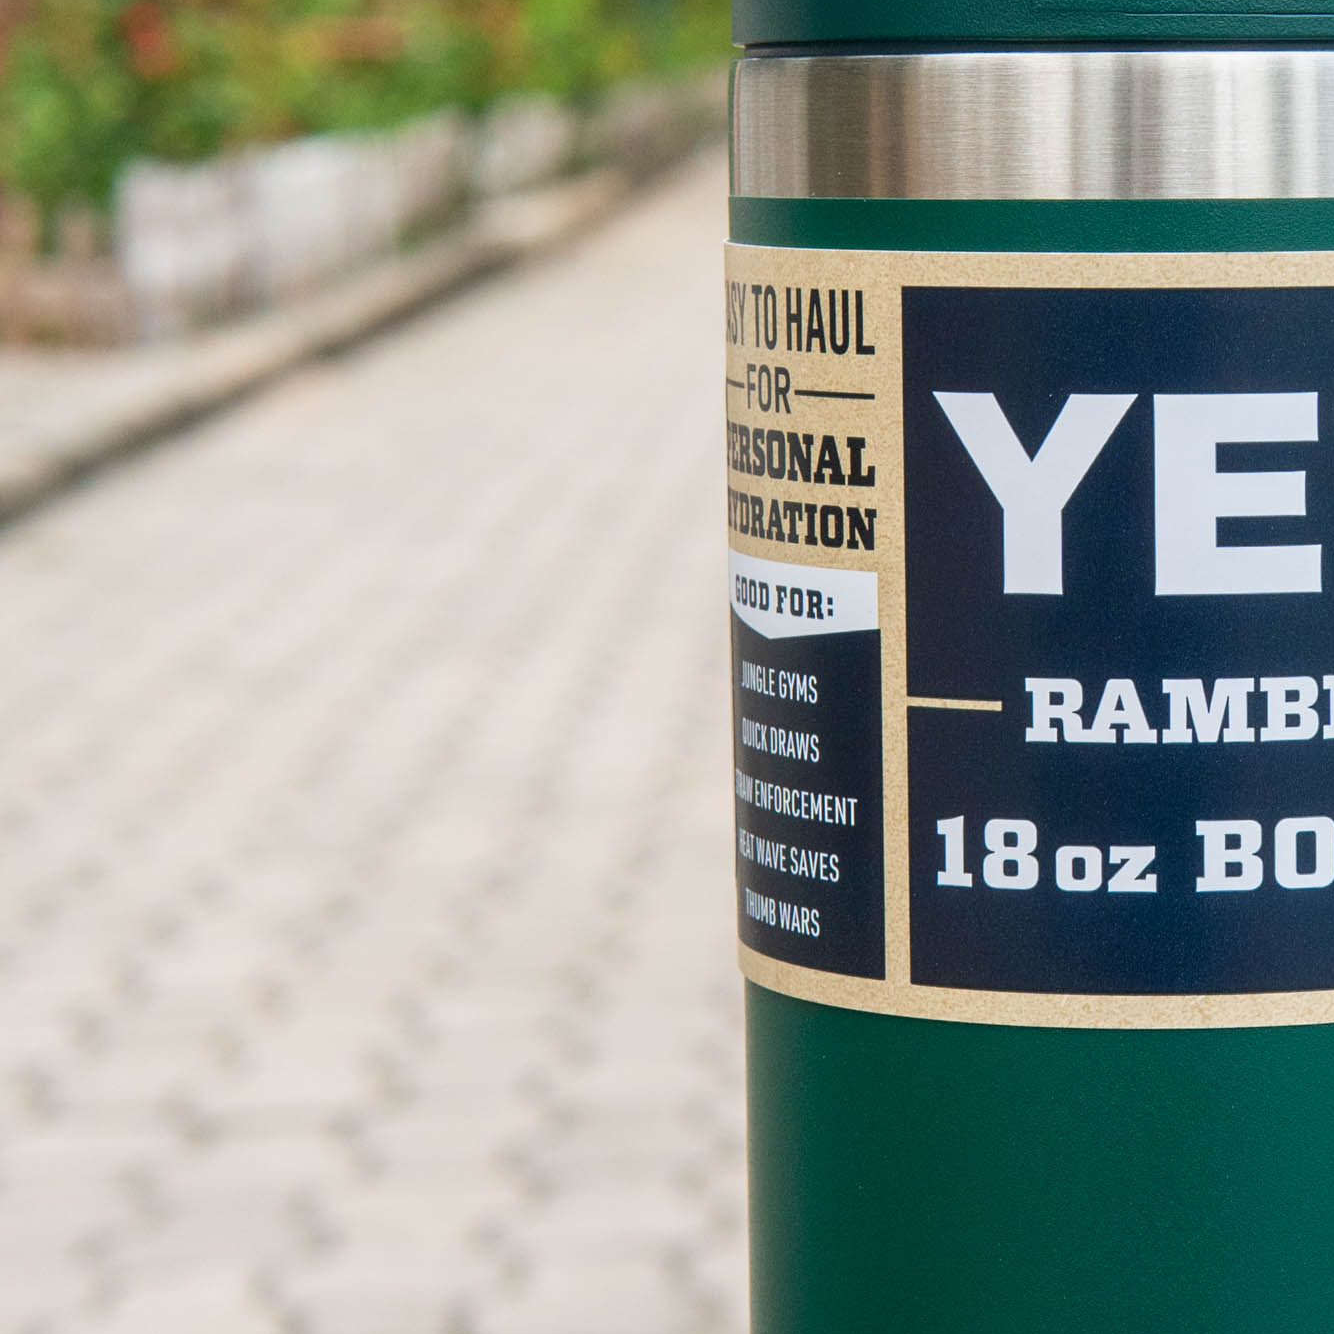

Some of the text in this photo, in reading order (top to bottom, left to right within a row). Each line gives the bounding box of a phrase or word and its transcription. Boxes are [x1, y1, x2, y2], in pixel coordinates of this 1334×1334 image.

[751, 284, 777, 350] TO
[786, 287, 876, 355] HAUL
[746, 363, 792, 414] FOR
[736, 574, 834, 620] GOOD FOR:
[741, 660, 818, 704] JUNGLE GYMS
[742, 717, 820, 763] QUICK DRAWS
[755, 778, 858, 827] ENFORCEMENT
[756, 836, 787, 873] WAVE
[790, 846, 840, 883] SAVES
[745, 887, 820, 938] THUMB WARS
